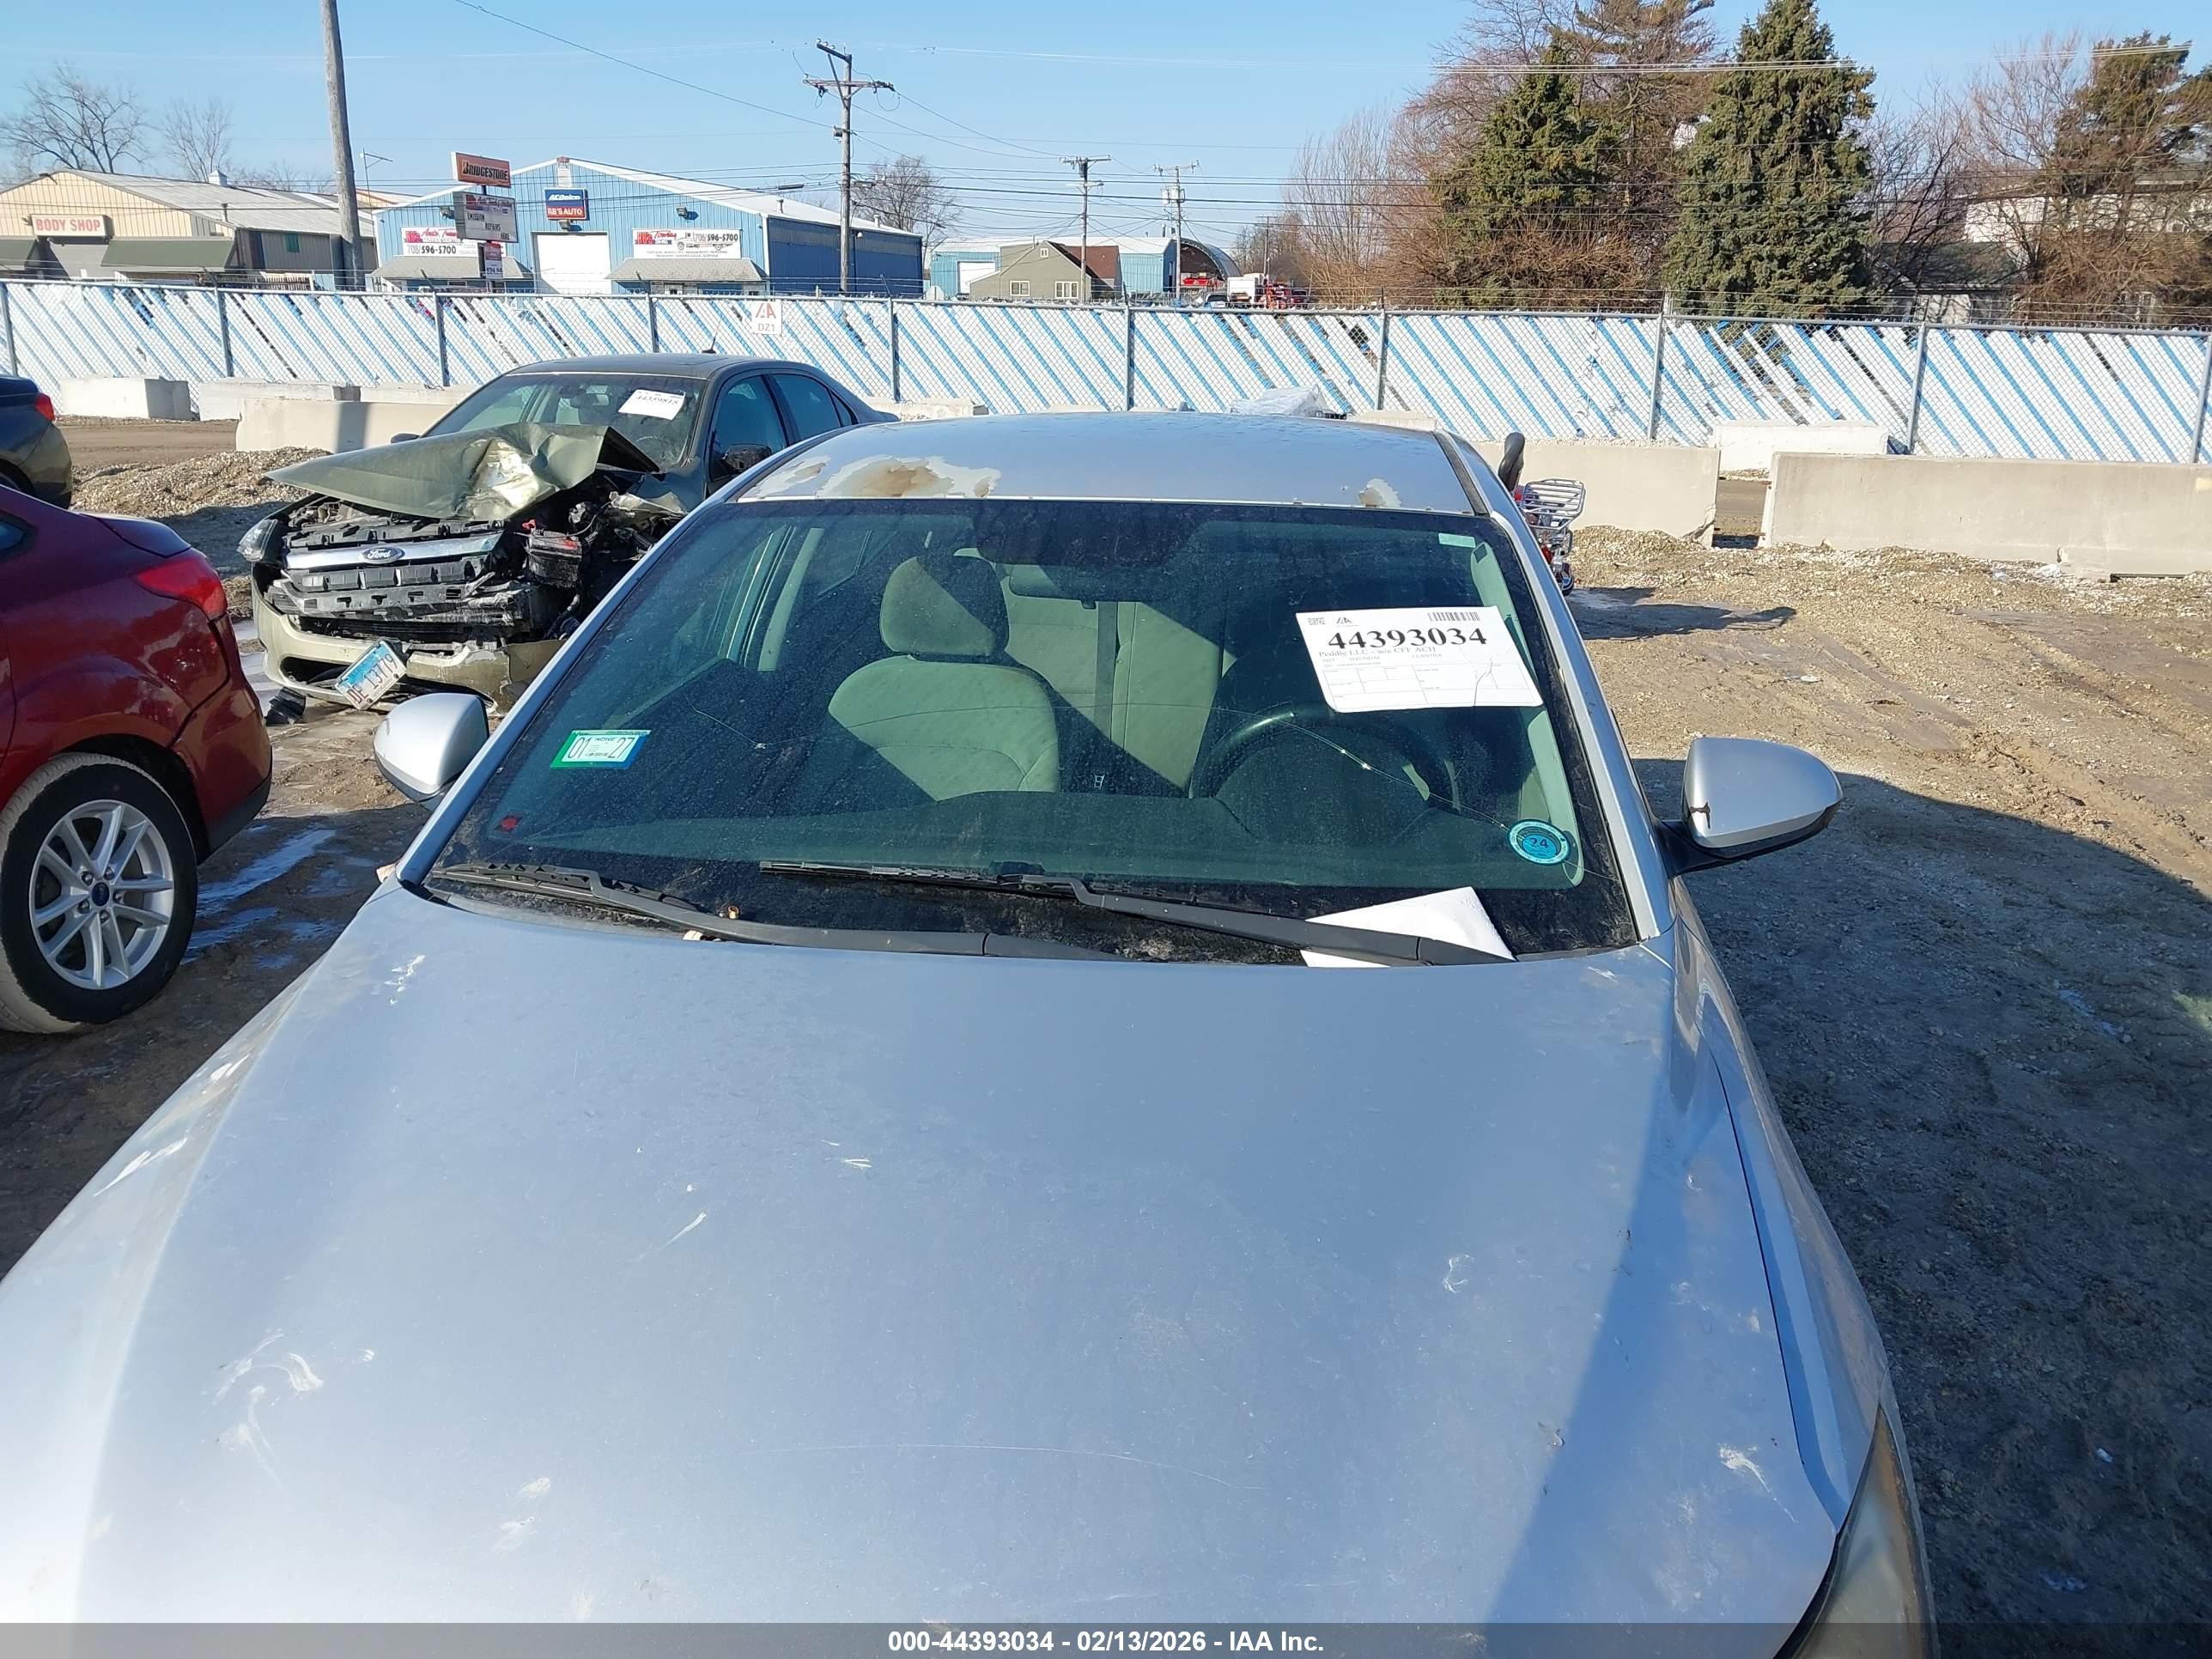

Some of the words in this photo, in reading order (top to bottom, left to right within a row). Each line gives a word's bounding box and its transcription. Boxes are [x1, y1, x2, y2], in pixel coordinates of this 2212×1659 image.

[463, 160, 508, 180] BRIDGESTONE
[35, 219, 66, 231] BODY
[70, 219, 100, 232] SHOP
[368, 548, 392, 558] Ford
[1328, 627, 1487, 649] 44393034
[568, 737, 592, 758] 01
[607, 737, 635, 758] 27
